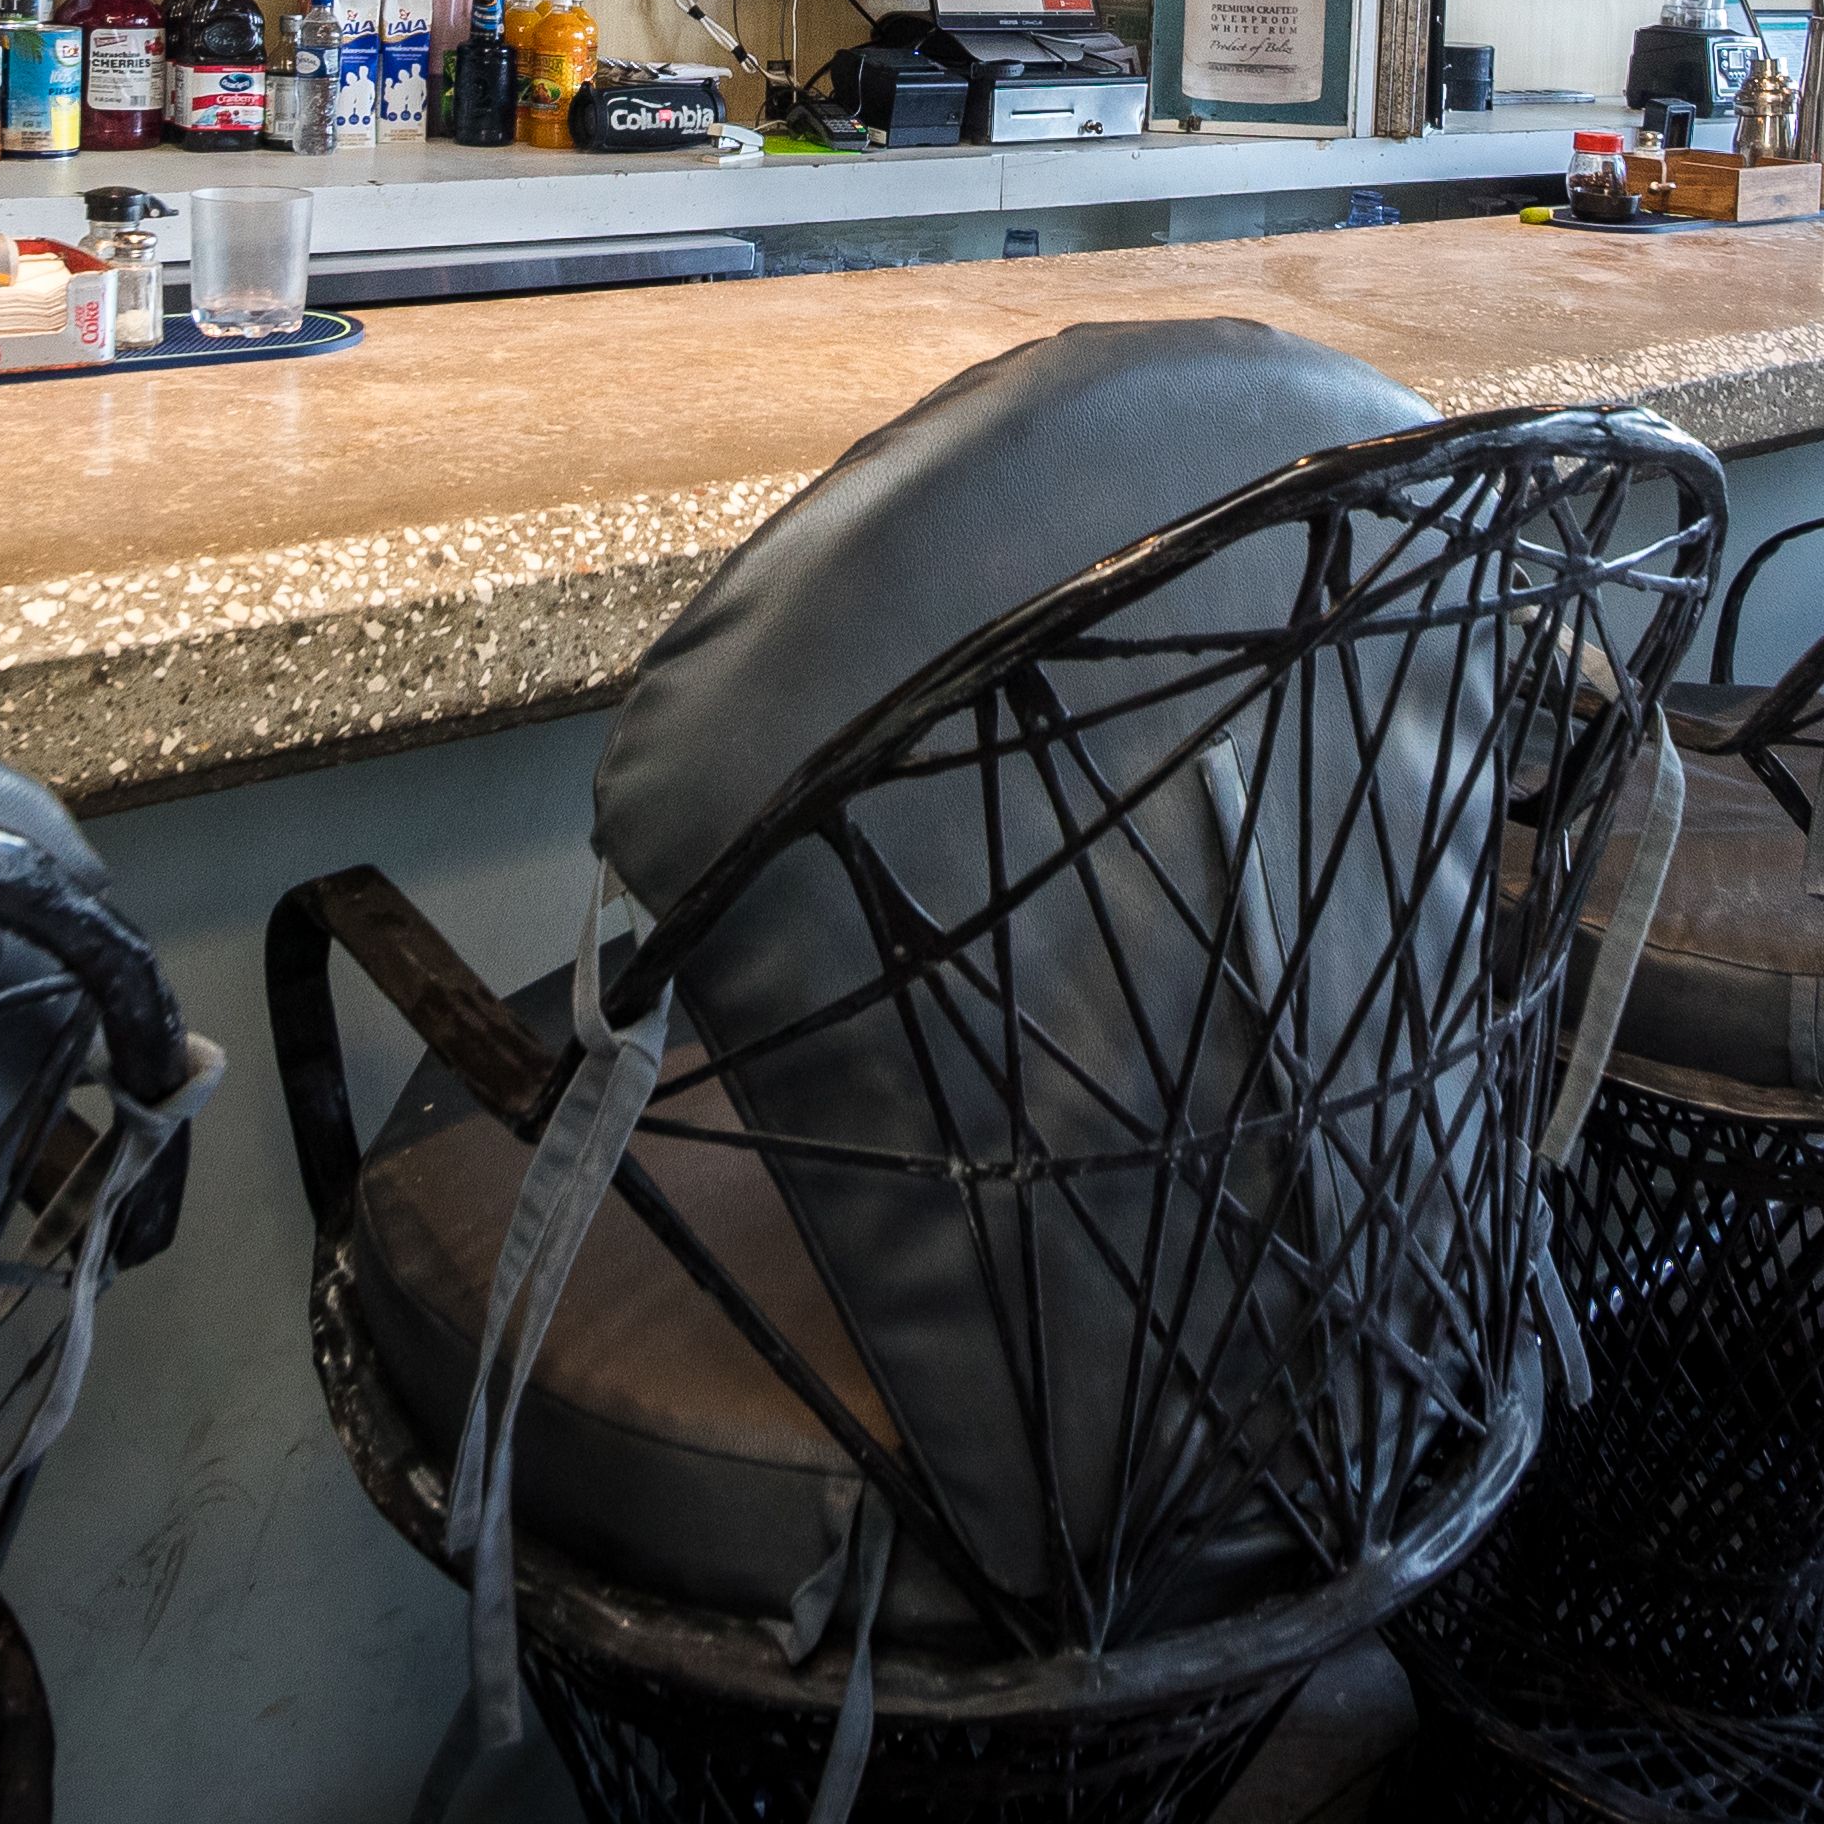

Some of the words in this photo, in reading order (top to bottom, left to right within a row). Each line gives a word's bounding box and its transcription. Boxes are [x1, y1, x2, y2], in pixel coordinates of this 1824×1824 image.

[1211, 3, 1255, 14] PREMIUM
[1256, 5, 1298, 15] CRAFTED
[1211, 14, 1298, 25] OVERPROOF
[387, 18, 428, 36] LALA
[1210, 24, 1260, 34] WHITE
[1268, 25, 1298, 35] RUM
[91, 58, 152, 69] CHERRIES
[610, 102, 715, 133] Columbia
[80, 299, 100, 345] Coke
